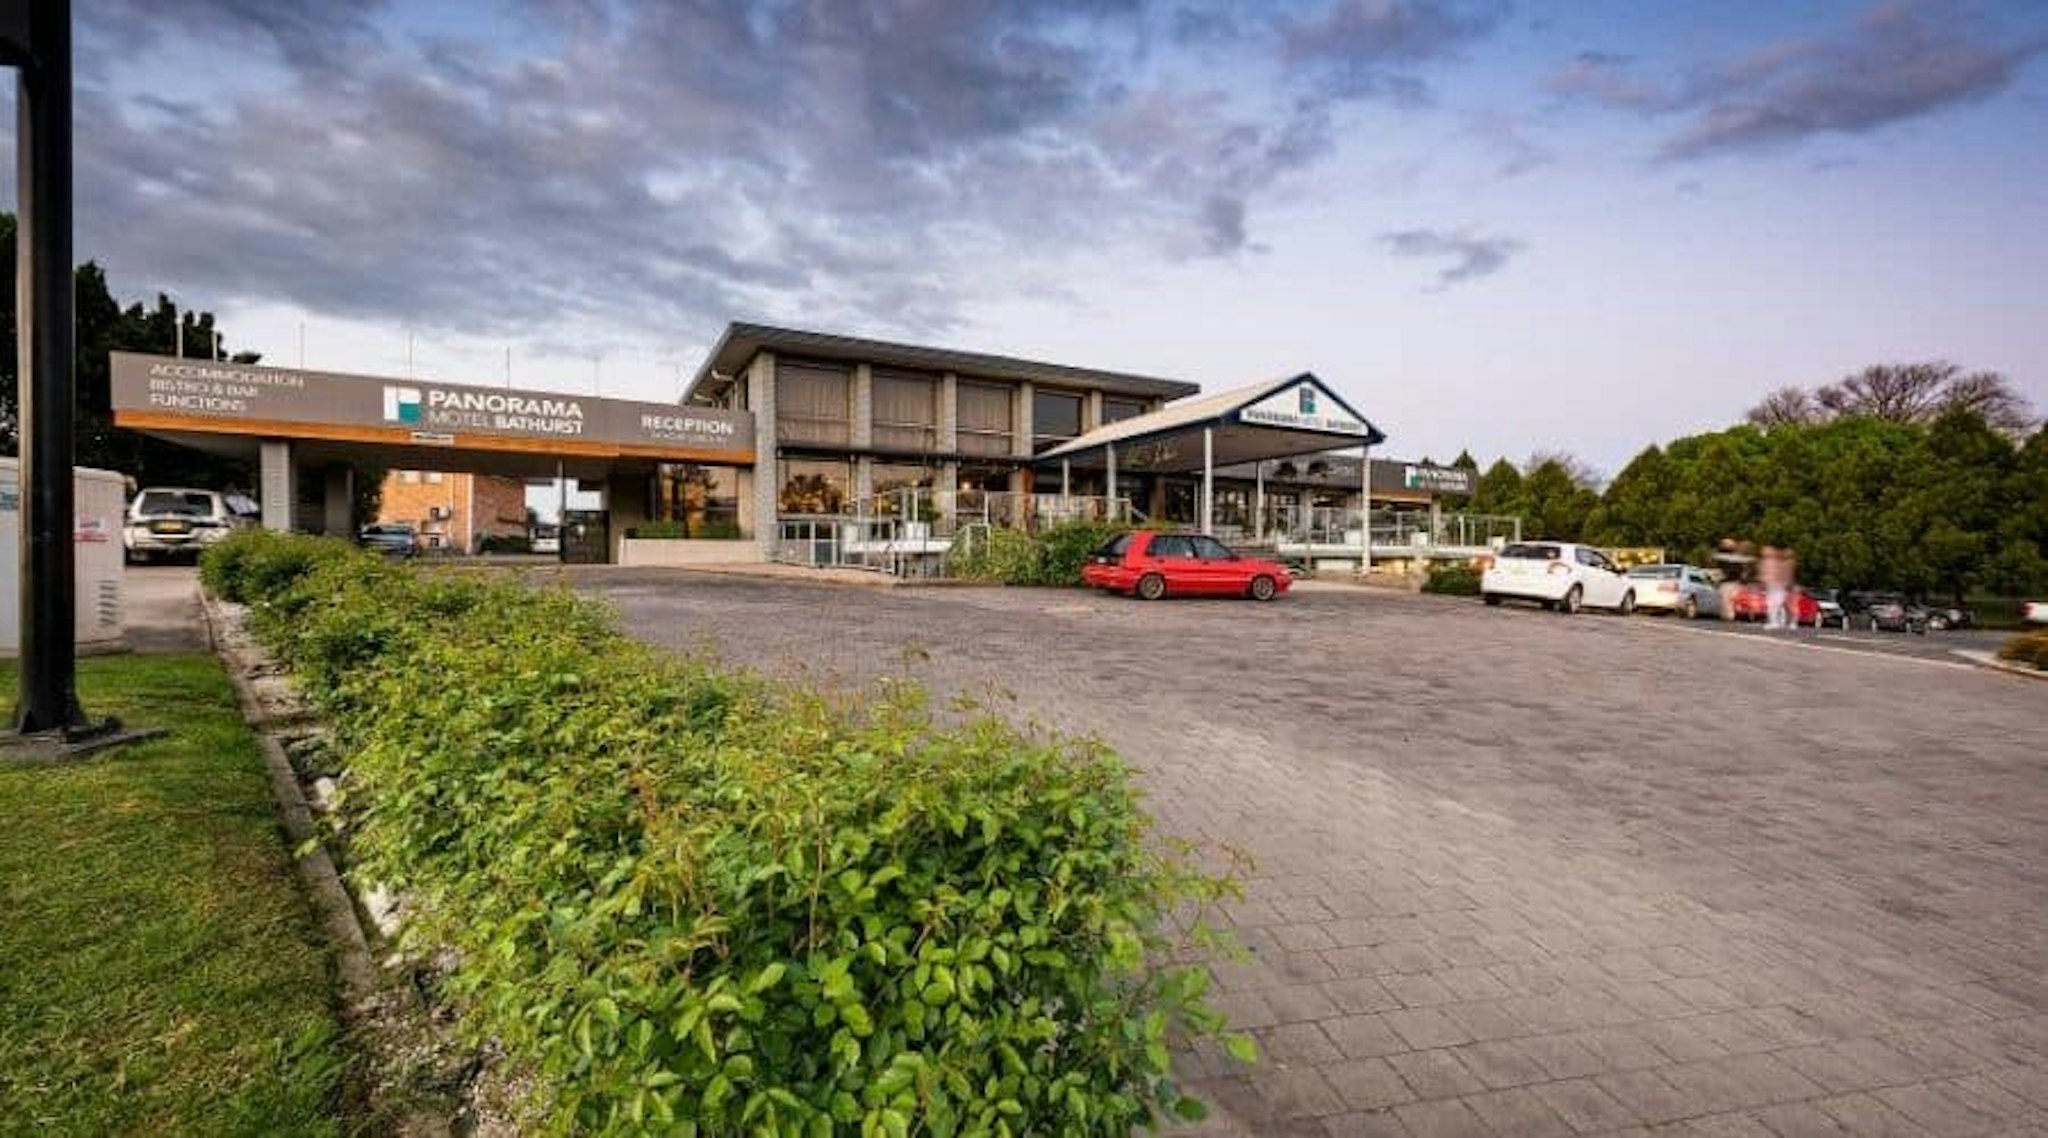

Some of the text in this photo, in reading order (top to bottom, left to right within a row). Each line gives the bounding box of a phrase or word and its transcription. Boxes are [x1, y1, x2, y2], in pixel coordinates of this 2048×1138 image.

[151, 393, 248, 411] FUNCTIONS
[428, 389, 584, 419] PANORAMA
[429, 410, 584, 434] MOTEL BATHURST
[640, 414, 735, 435] RECEPTION
